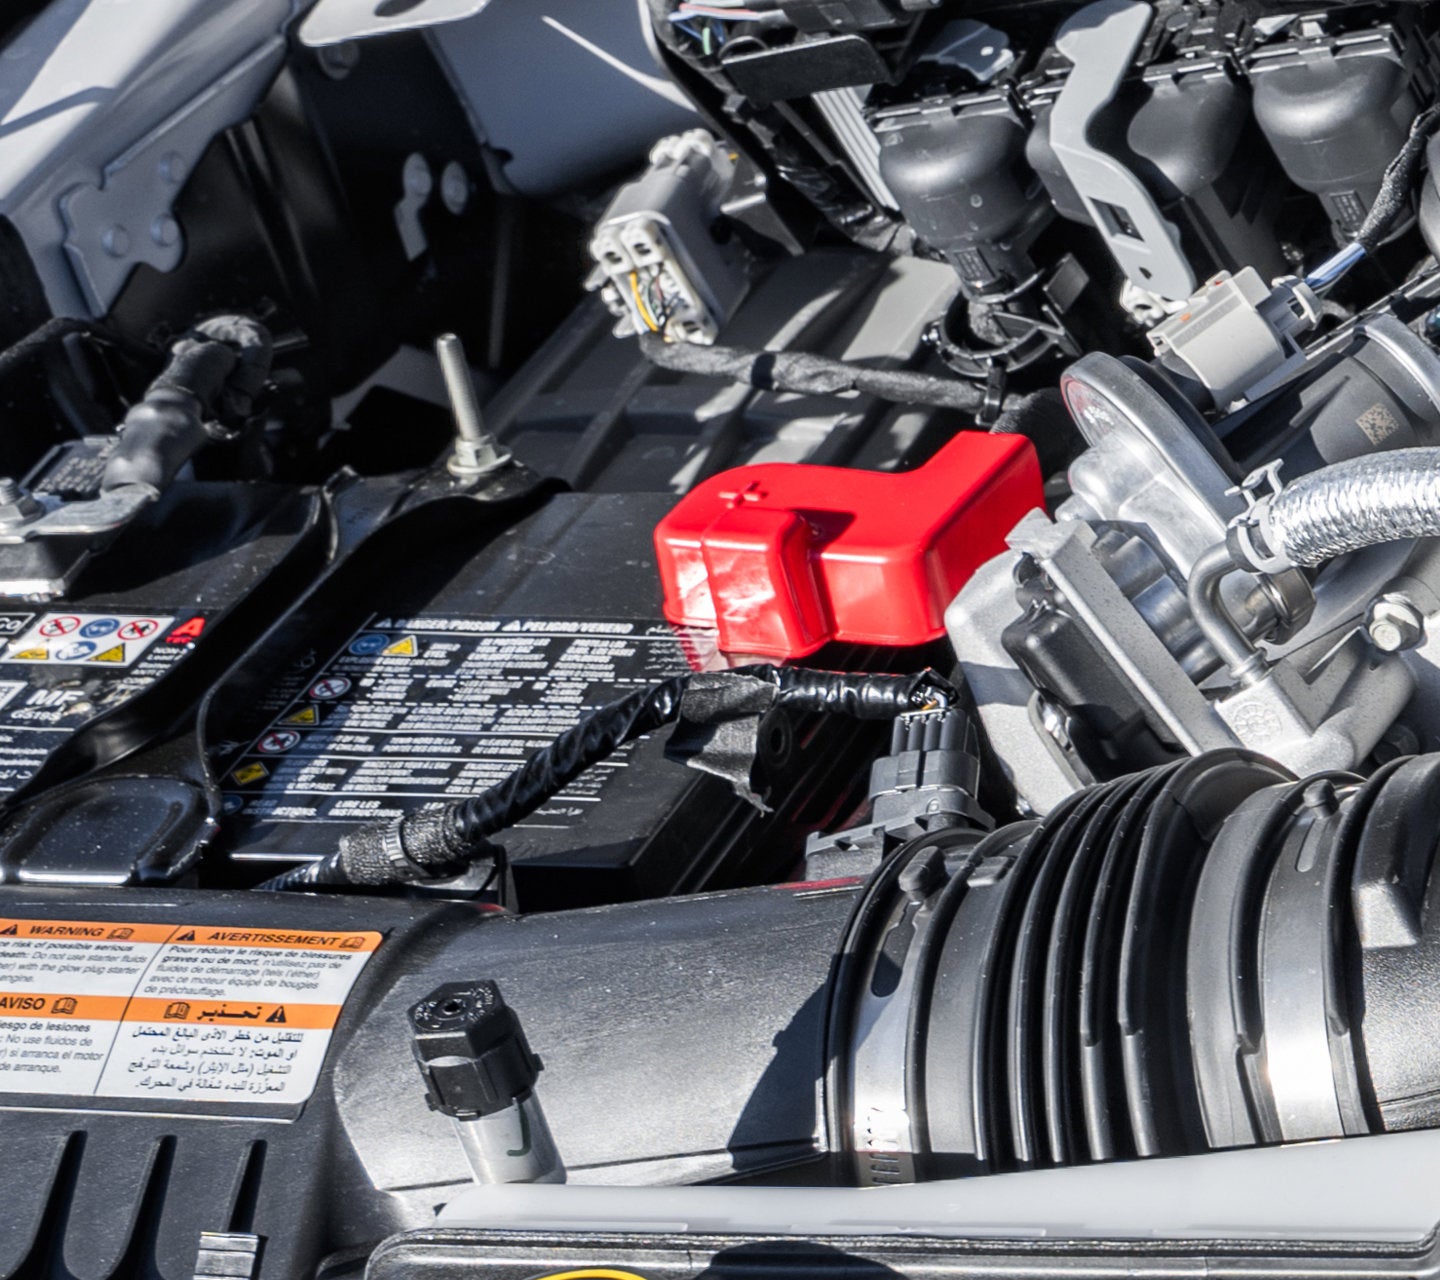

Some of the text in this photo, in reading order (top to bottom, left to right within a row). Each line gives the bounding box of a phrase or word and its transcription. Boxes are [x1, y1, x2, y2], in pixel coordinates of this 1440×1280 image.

[26, 689, 85, 707] MF
[29, 925, 341, 947] WARNING AVERTISSEMENT
[34, 941, 48, 949] of
[49, 942, 92, 952] possible
[49, 953, 65, 961] not
[66, 954, 86, 962] use
[86, 954, 120, 964] starter
[121, 954, 148, 964] fluids
[169, 945, 353, 961] Pour réduire le risque de blessures
[156, 964, 189, 974] fluides
[191, 966, 203, 975] de
[161, 956, 198, 966] graves
[201, 956, 218, 965] ou
[222, 957, 234, 966] de
[308, 961, 327, 971] pas
[328, 962, 342, 970] de
[149, 976, 174, 984] avec
[190, 977, 227, 986] moteur
[264, 979, 277, 988] de
[279, 980, 319, 990] bougies
[144, 985, 156, 994] de
[0, 997, 46, 1011] AVISO
[29, 1022, 43, 1031] de
[46, 1023, 91, 1032] lesiones
[6, 1035, 93, 1047] No use fluidos de
[20, 1050, 59, 1060] arranca
[73, 1052, 104, 1061] motor
